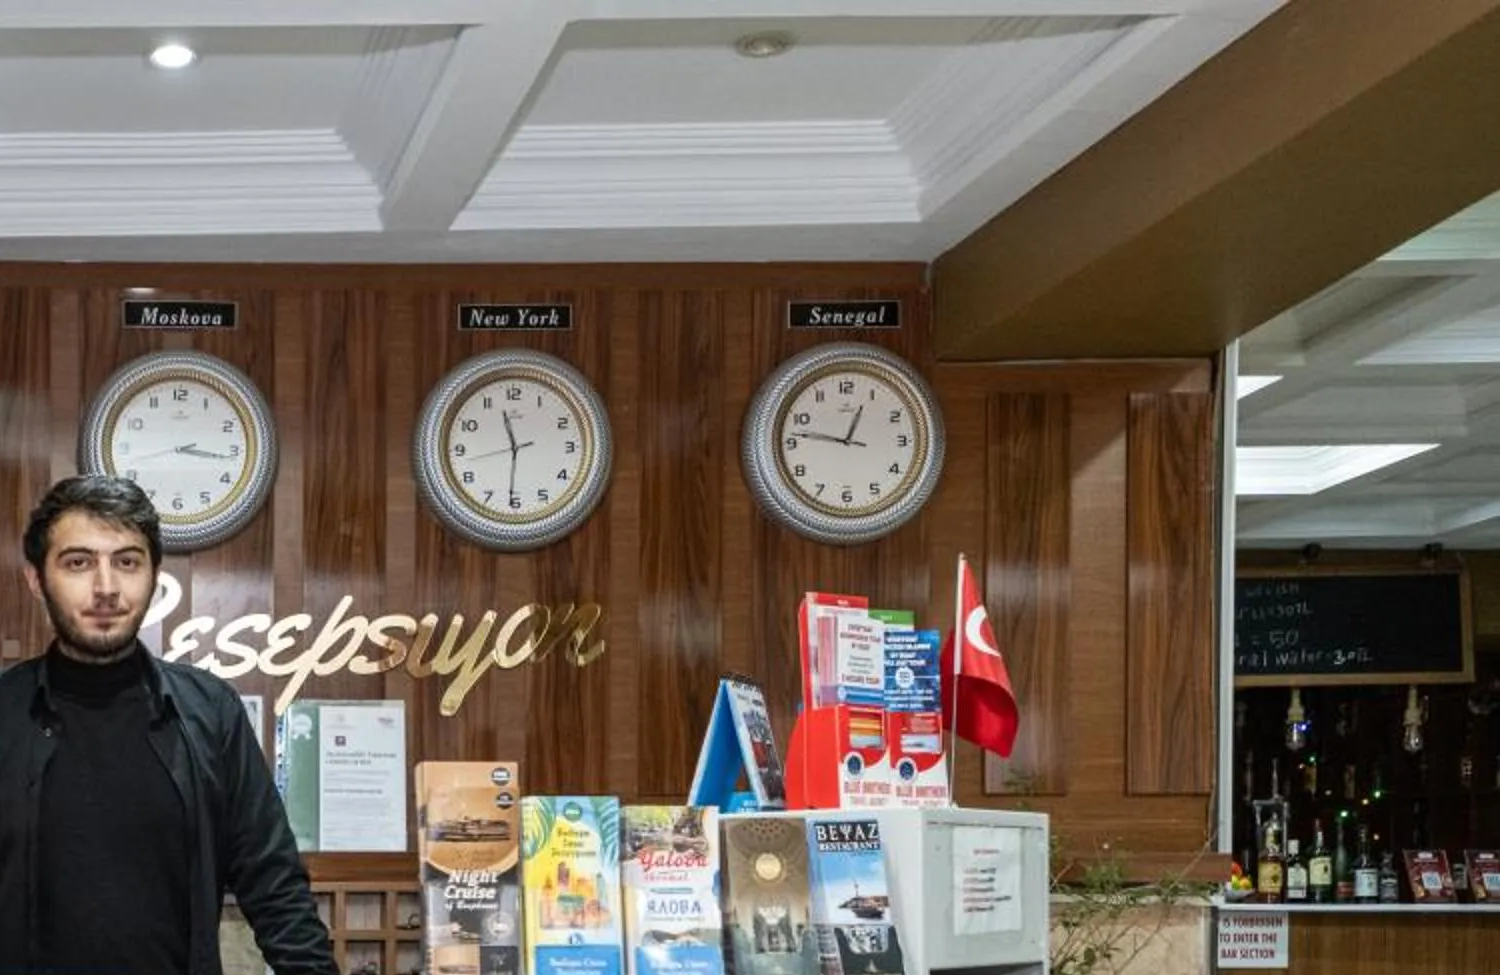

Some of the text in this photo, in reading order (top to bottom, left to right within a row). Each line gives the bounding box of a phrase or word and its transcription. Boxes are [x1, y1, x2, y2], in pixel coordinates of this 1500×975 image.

[140, 306, 223, 325] Moskova
[468, 308, 560, 327] New York
[808, 305, 885, 327] Senegal
[839, 381, 854, 394] 12
[173, 388, 189, 401] 12
[506, 388, 522, 400] 12
[816, 390, 824, 403] 11
[150, 396, 159, 409] 11
[483, 397, 492, 409] 11
[558, 417, 568, 429] 2
[794, 413, 810, 425] 10
[890, 411, 900, 423] 2
[128, 418, 143, 431] 10
[223, 420, 234, 433] 2
[461, 420, 478, 432] 10
[786, 438, 797, 450] 9
[897, 435, 907, 447] 3
[230, 445, 239, 457] 3
[455, 444, 466, 456] 9
[565, 441, 575, 454] 3
[557, 469, 567, 480] 4
[794, 464, 806, 477] 8
[889, 463, 899, 474] 4
[220, 472, 230, 484] 4
[463, 471, 474, 483] 8
[815, 483, 825, 496] 7
[869, 483, 880, 494] 5
[200, 491, 211, 504] 5
[484, 491, 493, 504] 7
[538, 490, 549, 501] 5
[841, 490, 852, 502] 6
[172, 498, 183, 510] 6
[815, 823, 879, 841] BEYAZ
[448, 870, 498, 887] Night
[444, 884, 497, 899] Cruise
[1220, 933, 1277, 943] TO ENTER THE
[1221, 948, 1275, 959] BAR SECTION
